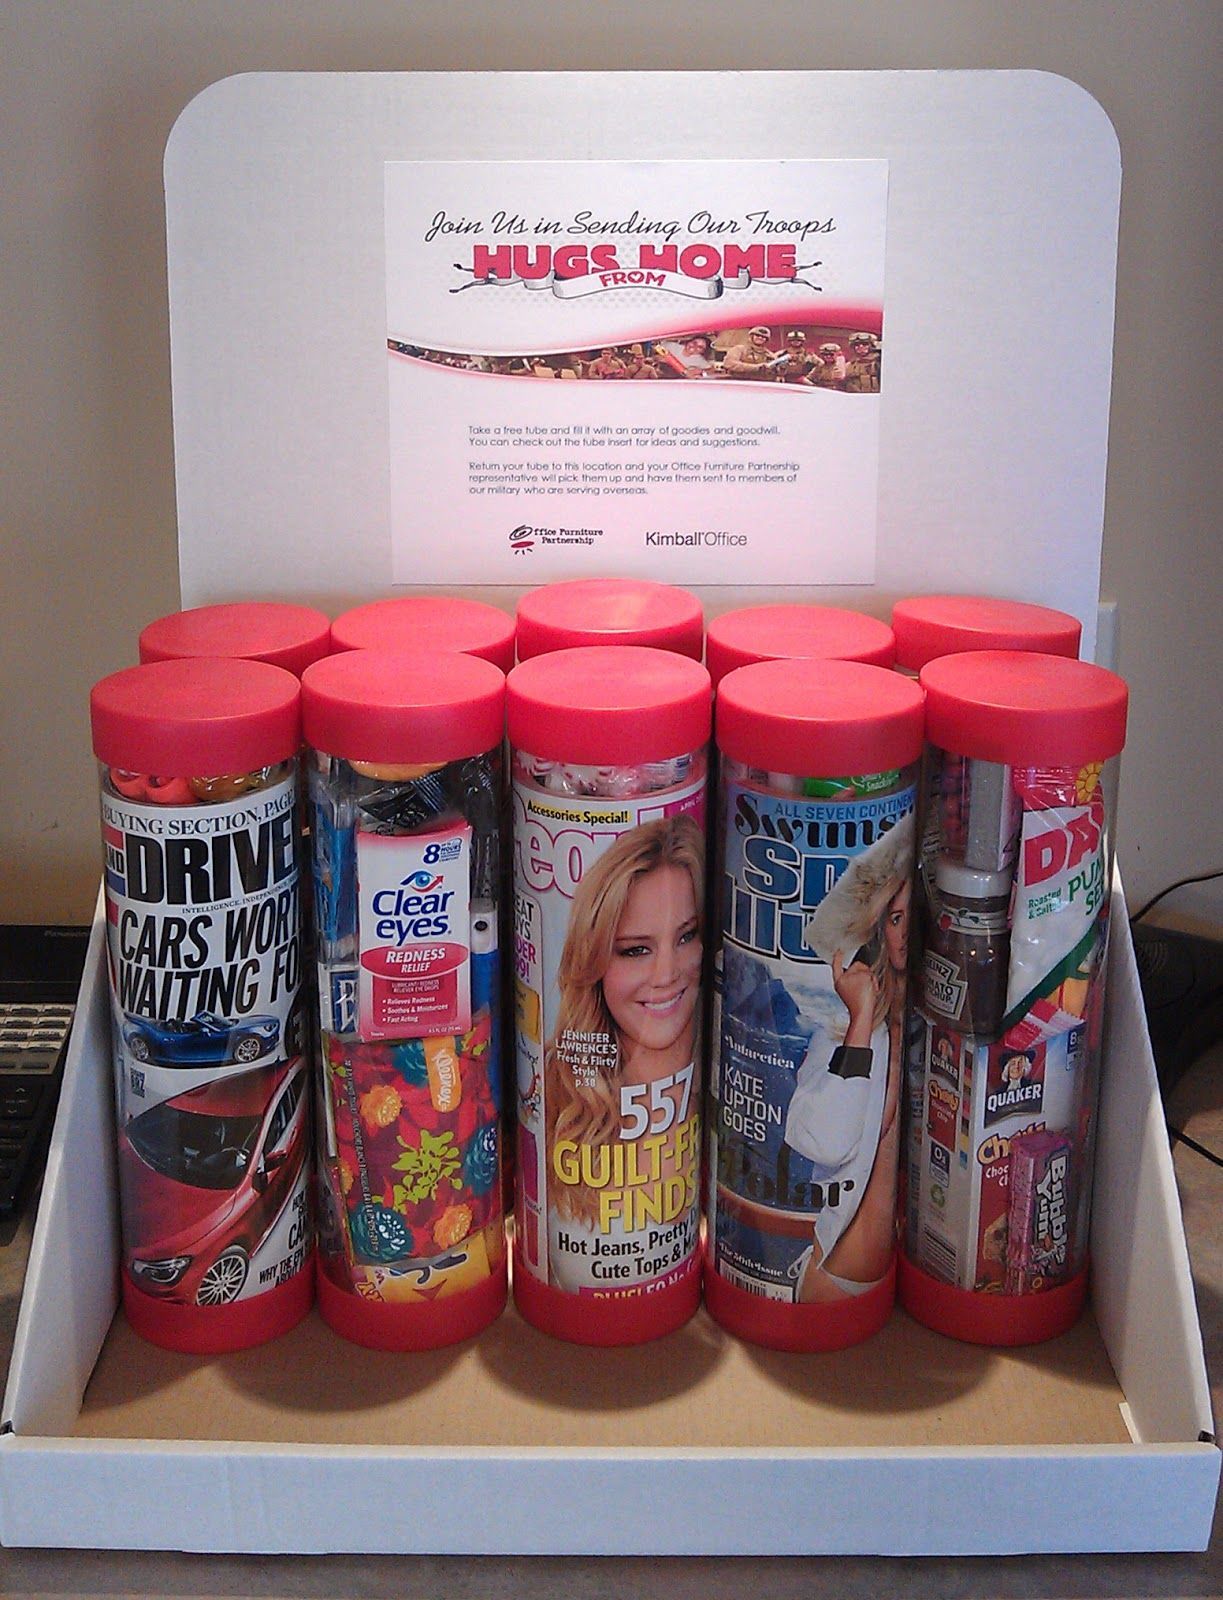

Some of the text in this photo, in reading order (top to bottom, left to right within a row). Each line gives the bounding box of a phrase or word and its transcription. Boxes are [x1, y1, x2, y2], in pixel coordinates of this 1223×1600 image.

[425, 211, 836, 242] Join Us in Sending Our Troops
[473, 244, 797, 280] HUGS HOME
[599, 271, 667, 288] FROM
[468, 425, 491, 435] Take
[504, 425, 522, 435] free
[526, 425, 548, 435] tube
[551, 425, 570, 435] and
[573, 425, 582, 435] fill
[585, 425, 590, 435] it
[593, 425, 613, 435] with
[616, 425, 629, 435] an
[631, 425, 655, 435] array
[659, 425, 669, 435] of
[672, 425, 710, 435] goodies
[713, 425, 734, 435] and
[736, 425, 781, 435] goodwill.
[468, 438, 760, 447] You can check out the tube insert for ideas and suggestions.
[469, 474, 797, 484] representative will pick them up and have them sent to members of
[502, 462, 524, 472] your
[526, 462, 549, 472] tube
[552, 462, 562, 472] to
[565, 462, 579, 472] this
[583, 462, 622, 472] location
[625, 462, 644, 472] and
[647, 462, 668, 472] your
[671, 462, 701, 472] Office
[704, 462, 744, 472] Furniture
[748, 462, 800, 472] Partnership
[469, 486, 648, 496] our military who are serving overseas.
[541, 536, 594, 546] Partnership
[559, 528, 604, 537] Furniture
[169, 810, 262, 835] SECTION,
[527, 800, 629, 825] Accessories Special!
[774, 802, 801, 817] ALL
[805, 806, 856, 820] SEVEN
[125, 810, 293, 905] DRIVE
[423, 844, 441, 865] 8
[373, 889, 455, 917] Clear
[1028, 887, 1062, 908] Roasted
[120, 909, 213, 969] CARS
[386, 947, 446, 964] REDNESS
[400, 961, 431, 974] RELIEF
[119, 958, 260, 1023] WAITING
[555, 1040, 618, 1054] LAWRENCE'S
[561, 1029, 610, 1043] JENNIFER
[557, 1053, 617, 1067] Fresh & Flirty
[725, 1035, 795, 1070] Antarctica
[572, 1063, 599, 1077] Style!
[931, 1054, 959, 1080] QUAKER
[724, 1063, 764, 1099] KATE
[619, 1062, 695, 1140] 557
[724, 1087, 782, 1125] UPTON
[987, 1084, 1043, 1111] QUAKER
[723, 1108, 766, 1142] GOES
[600, 1165, 698, 1234] FINDS
[558, 1232, 587, 1255] Hot
[591, 1238, 645, 1257] Jeans,
[650, 1219, 689, 1249] Pretty
[591, 1262, 630, 1279] Cute
[634, 1255, 670, 1276] Tops
[671, 1243, 682, 1263] &
